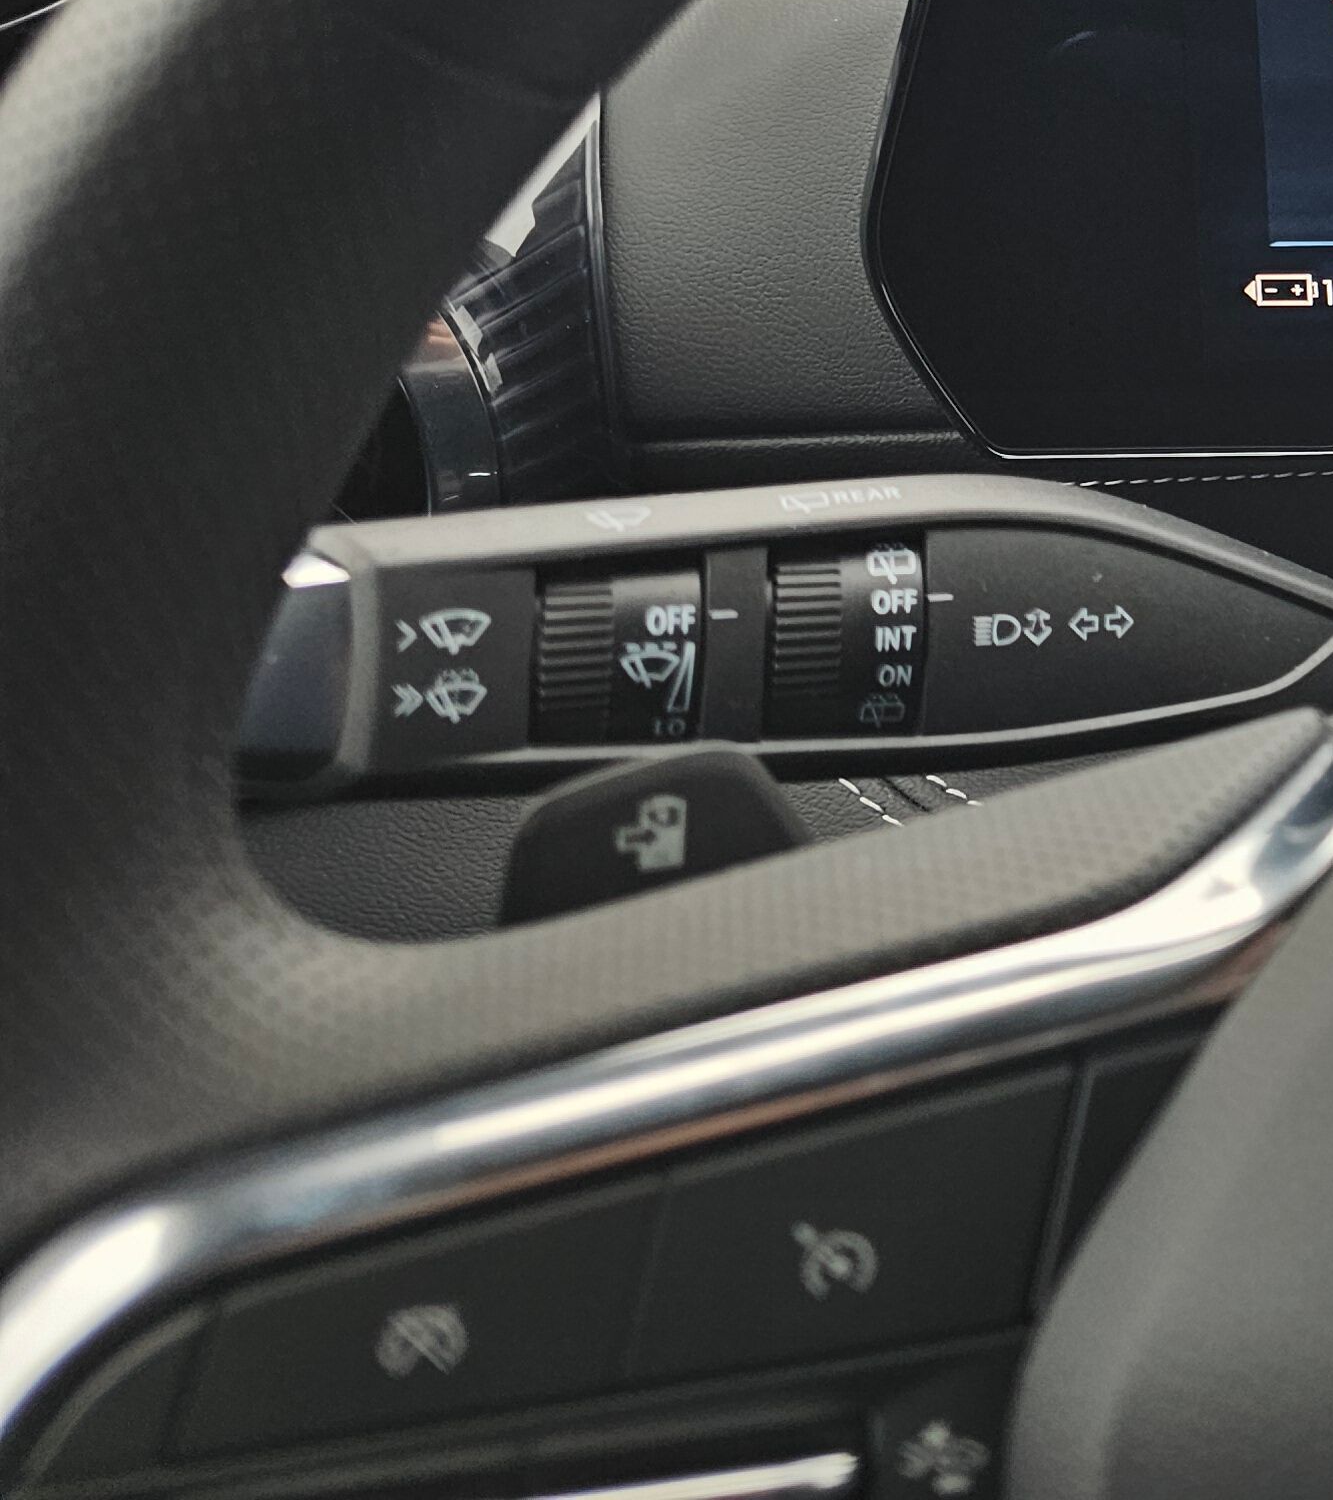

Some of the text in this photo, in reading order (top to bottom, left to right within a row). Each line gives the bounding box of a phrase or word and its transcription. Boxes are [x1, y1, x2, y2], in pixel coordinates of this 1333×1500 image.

[833, 485, 903, 507] REAR
[871, 588, 919, 615] OFF
[646, 603, 697, 636] OFF
[876, 625, 916, 652] INT
[879, 665, 912, 686] ON
